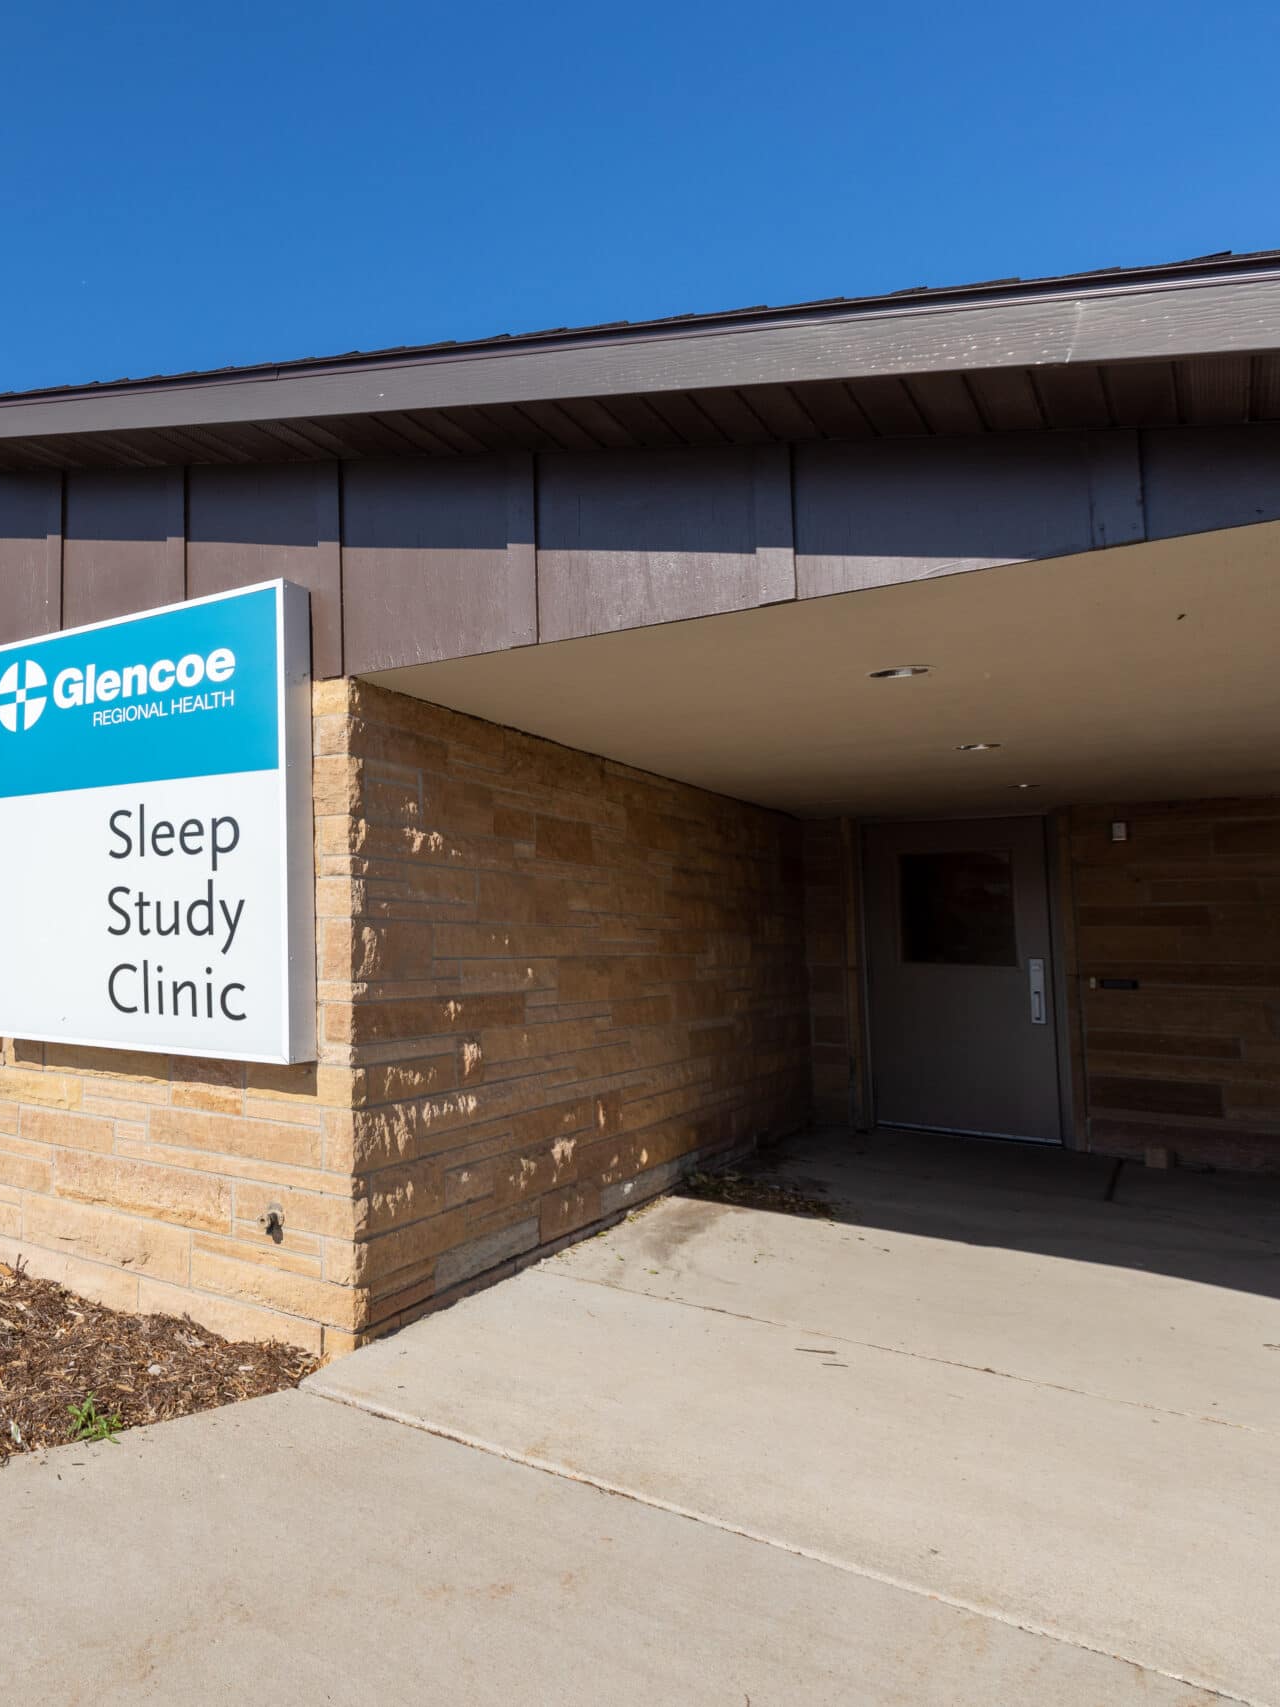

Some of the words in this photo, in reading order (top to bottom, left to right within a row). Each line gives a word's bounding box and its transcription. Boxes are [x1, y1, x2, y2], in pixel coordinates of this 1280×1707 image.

[52, 647, 236, 709] Glencoe
[92, 701, 168, 727] REGIONAL
[170, 689, 235, 717] HEALTH
[108, 803, 240, 872] Sleep
[107, 878, 245, 955] Study
[108, 959, 247, 1021] Clinic
